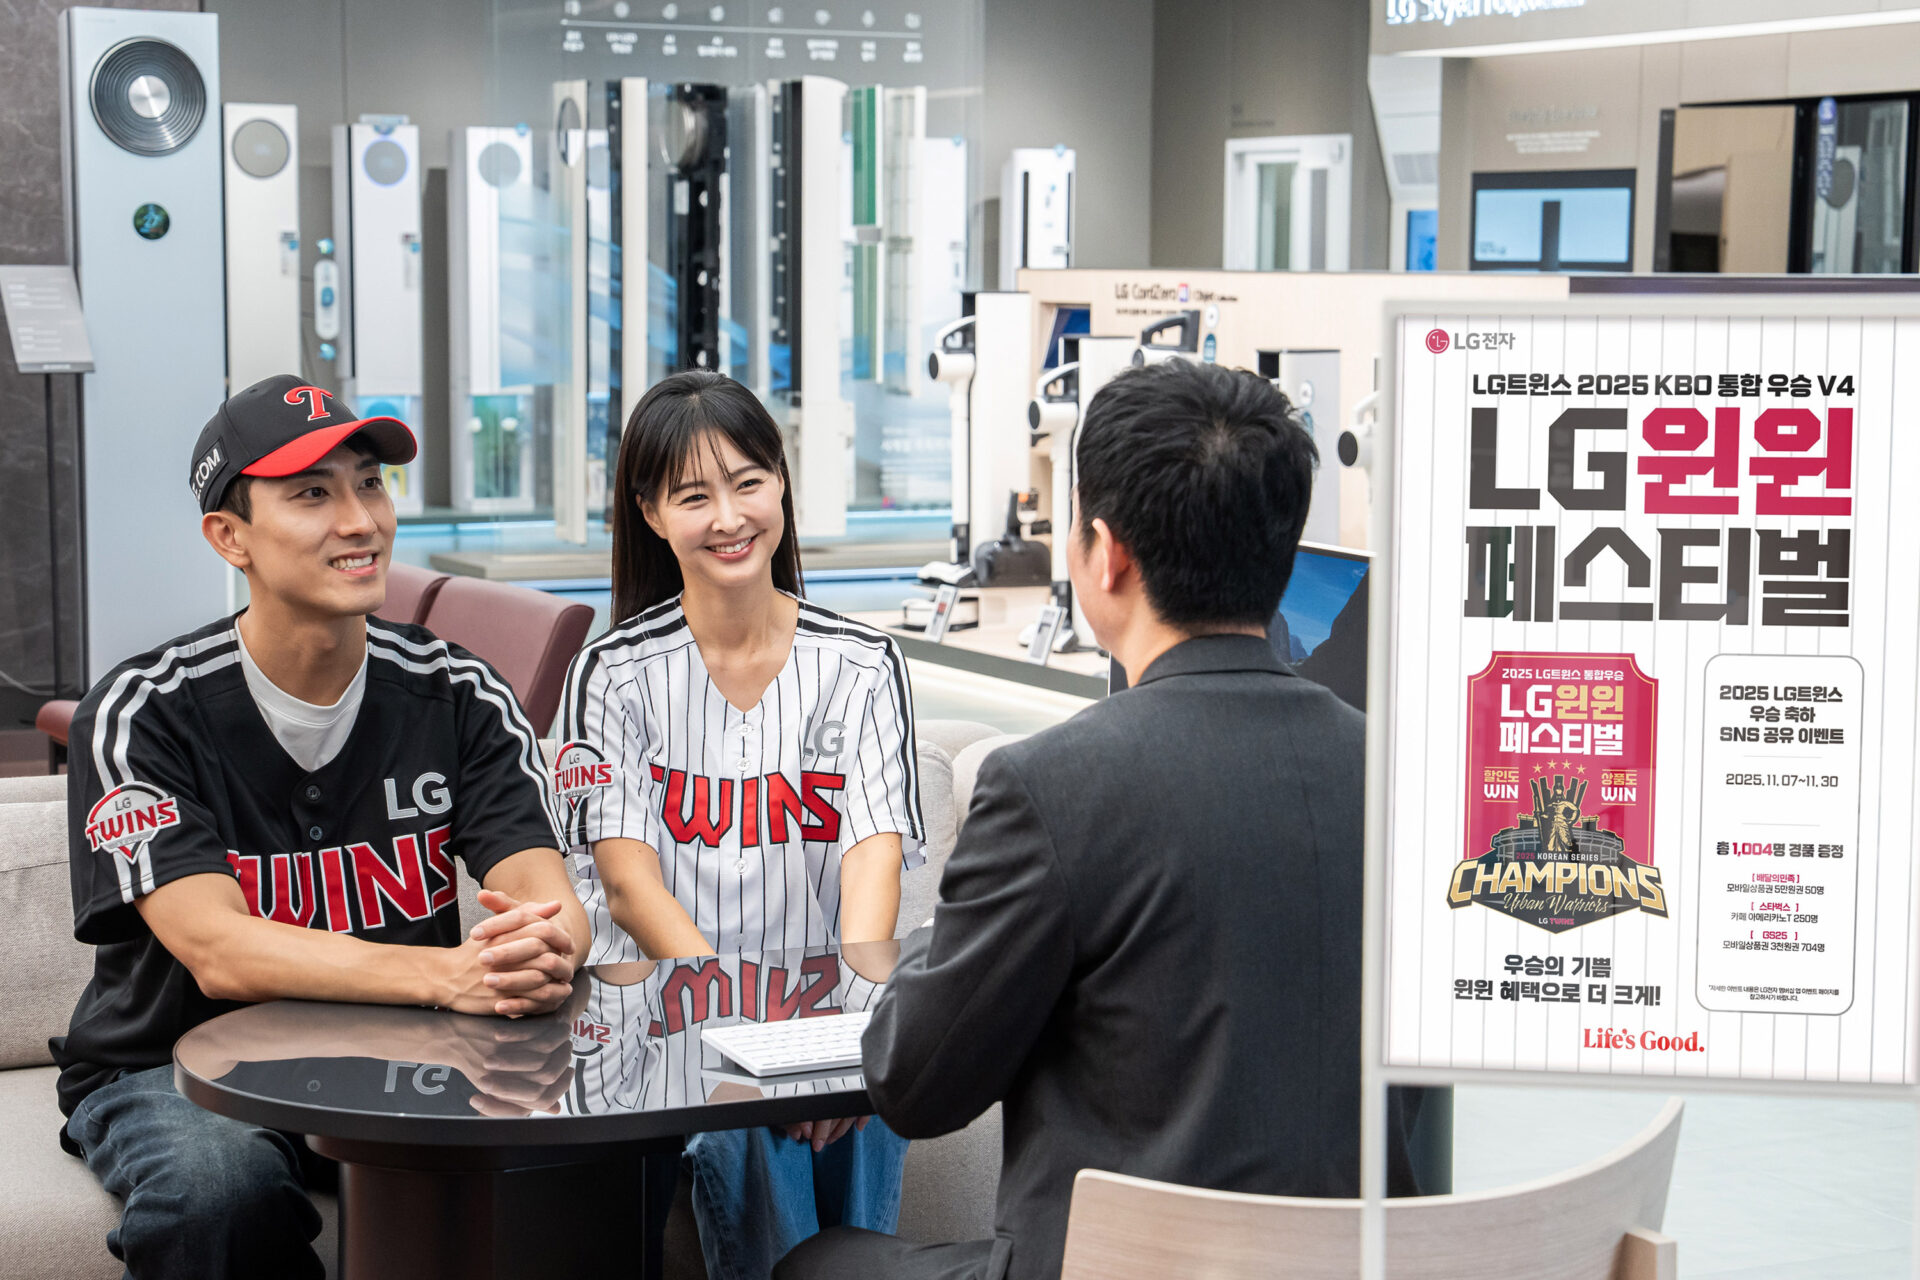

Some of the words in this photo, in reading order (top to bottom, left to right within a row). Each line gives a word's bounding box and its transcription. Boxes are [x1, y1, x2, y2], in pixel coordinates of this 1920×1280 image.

[1454, 332, 1516, 350] LG전자
[1473, 373, 1572, 396] LG트윈스
[1577, 374, 1649, 396] 2025
[1654, 374, 1712, 396] KBO
[1717, 373, 1763, 397] 통합
[1767, 374, 1812, 397] 우승
[1816, 375, 1856, 397] V4
[284, 386, 334, 421] T
[1469, 407, 1853, 516] LG윈윈
[1464, 525, 1851, 627] 페스티벌
[1502, 668, 1532, 679] 2025
[1535, 668, 1581, 681] LG트윈스
[1584, 669, 1625, 681] 통합우승
[1500, 683, 1624, 721] LG윈윈
[1720, 685, 1769, 701] 2025
[1773, 686, 1843, 703] LG트윈스
[1750, 705, 1781, 723] 우승
[1784, 706, 1816, 723] 축하
[803, 714, 847, 758] LG
[1499, 721, 1624, 756] 페스티벌
[1720, 726, 1760, 742] SNS
[1763, 727, 1794, 744] 공유
[1798, 728, 1844, 744] 이벤트
[568, 754, 580, 765] LG
[555, 764, 612, 793] TWINS
[1483, 770, 1520, 783] 할인도
[1601, 772, 1638, 786] 상품도
[384, 771, 453, 820] LG
[1483, 784, 1519, 799] WIN
[1601, 787, 1637, 802] WIN
[115, 797, 132, 811] LG
[86, 801, 177, 849] TWINS
[1516, 852, 1535, 860] 2025
[1537, 852, 1569, 861] KOREAN
[1570, 853, 1599, 862] SERIES
[1716, 841, 1729, 856] 총
[1732, 842, 1786, 857] 1,004명
[1789, 843, 1815, 858] 경품
[1818, 844, 1844, 859] 증정
[226, 822, 458, 934] WINS
[1449, 860, 1665, 911] CHAMPIONS
[1726, 883, 1773, 894] 모바일상품권
[1774, 885, 1804, 895] 5만원권
[1805, 885, 1825, 895] 50명
[1503, 893, 1545, 913] Urban
[1549, 895, 1608, 916] Warriors
[1759, 902, 1791, 912] 스타벅스
[1731, 912, 1747, 921] 카페
[1793, 914, 1819, 924] 250명
[1762, 931, 1788, 940] GS25
[1723, 940, 1769, 951] 모바일상품권
[1770, 942, 1800, 952] 3천원권
[1801, 943, 1825, 953] 704명
[1504, 954, 1564, 976] 우승의
[1571, 957, 1612, 978] 기쁨
[1453, 979, 1494, 1001] 윈윈
[1500, 981, 1581, 1003] 혜택으로
[1587, 984, 1607, 1005] 더
[1613, 985, 1661, 1006] 크게!
[1639, 1030, 1705, 1053] Good.
